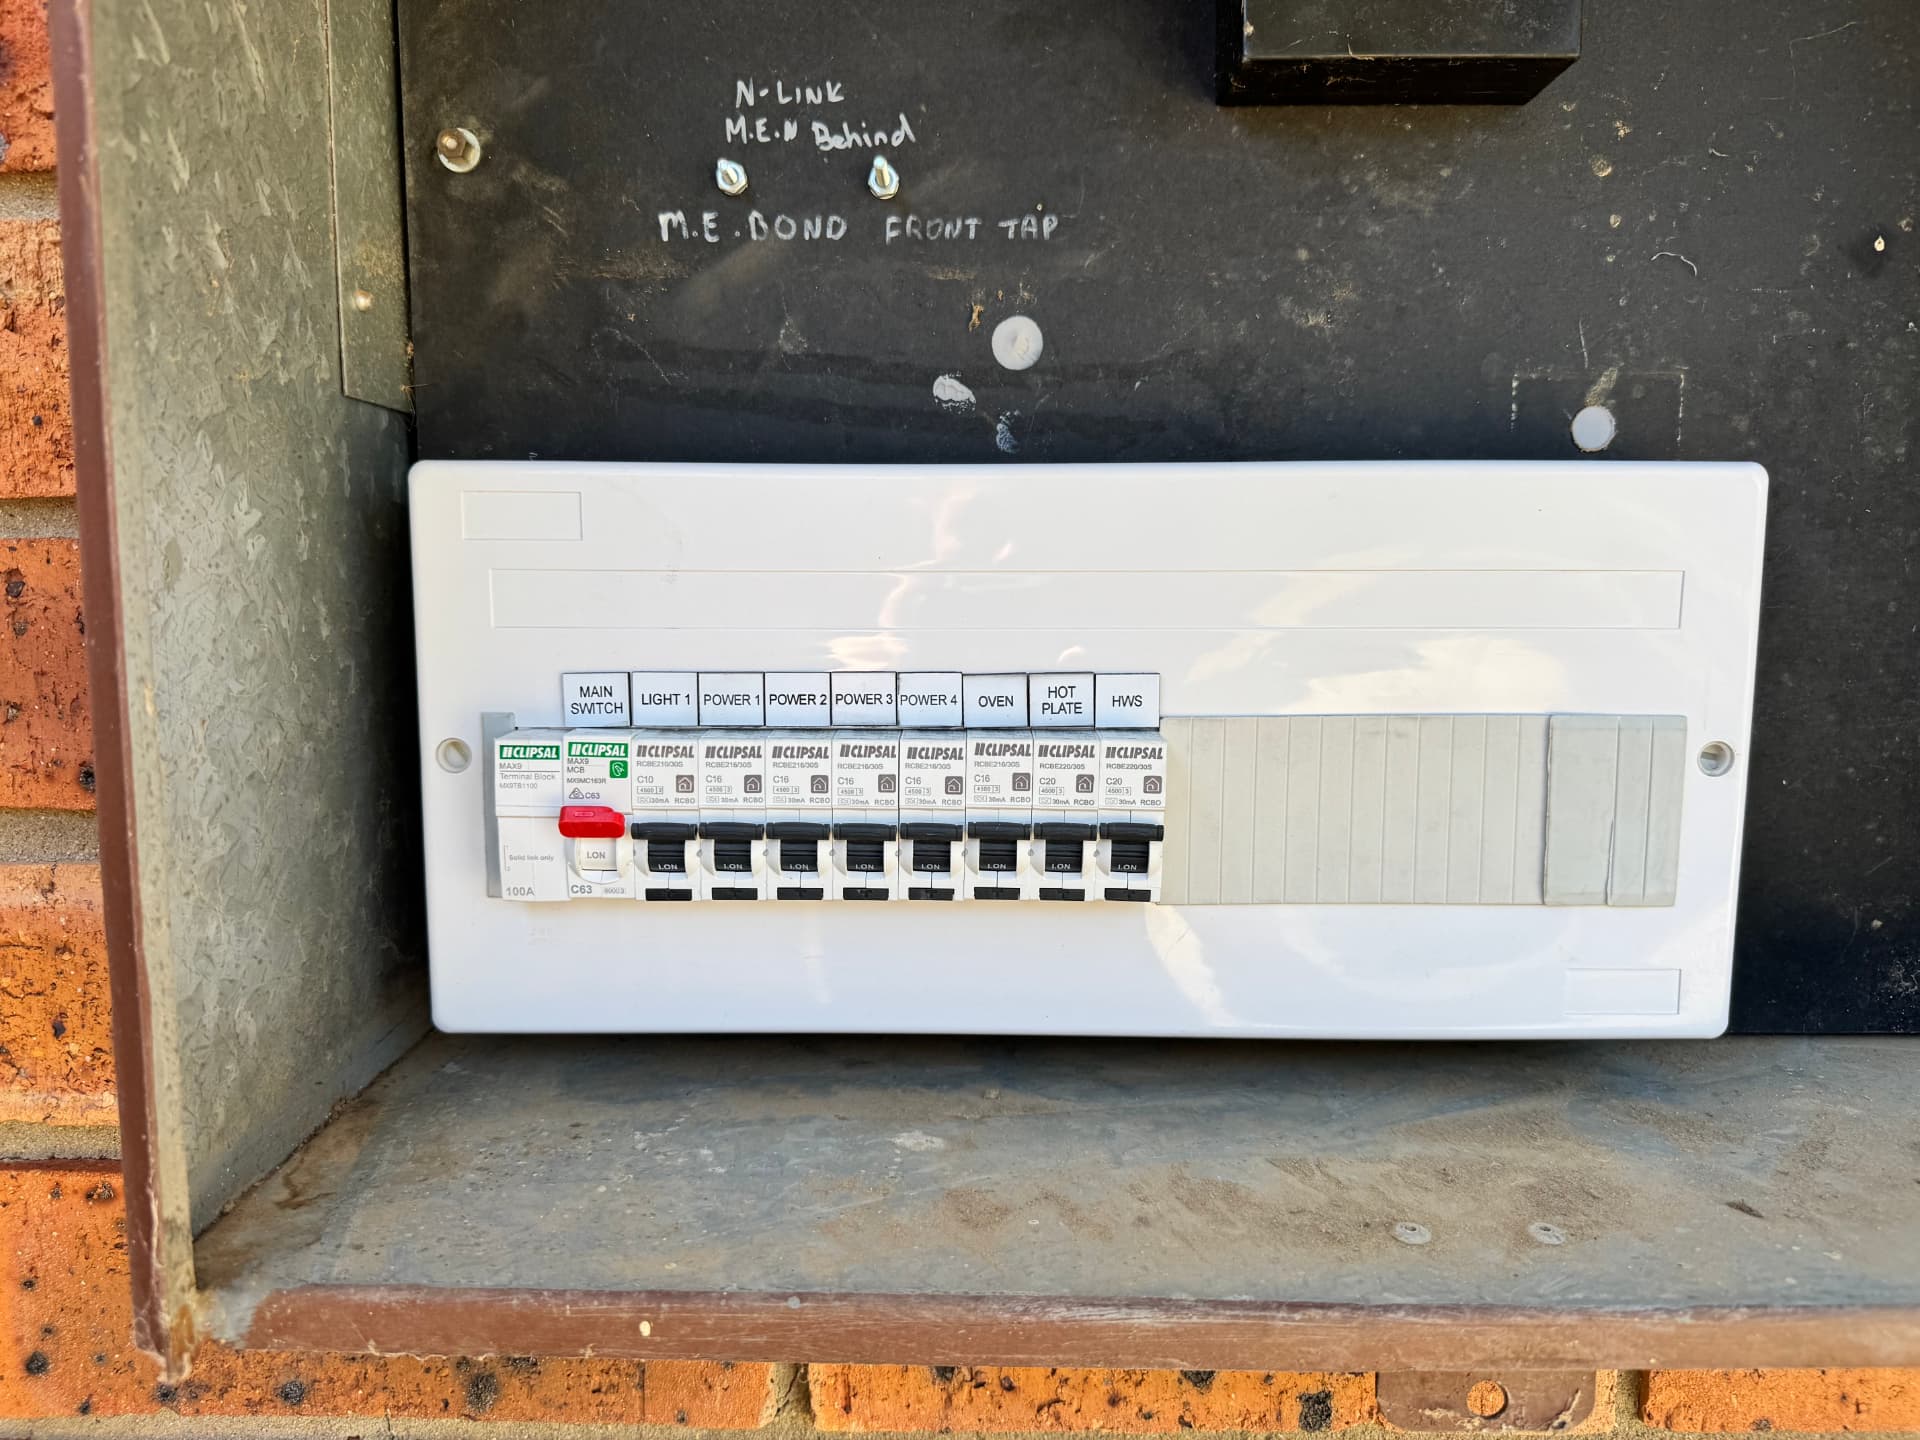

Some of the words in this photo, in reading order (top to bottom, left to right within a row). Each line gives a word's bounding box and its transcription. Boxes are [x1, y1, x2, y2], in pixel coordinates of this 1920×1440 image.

[735, 80, 845, 107] N-LINK
[812, 113, 916, 151] Behind
[885, 214, 982, 245] FRONT
[998, 214, 1058, 242] TAP
[579, 686, 613, 698] MAIN
[1047, 686, 1076, 698] HOT
[641, 693, 681, 705] LIGHT
[685, 693, 690, 705] 1
[703, 693, 751, 706] POWER
[755, 694, 760, 706] 1
[769, 693, 816, 705] POWER
[820, 694, 827, 705] 2
[835, 693, 883, 705] POWER
[886, 693, 893, 705] 3
[900, 694, 947, 706] POWER
[950, 694, 957, 706] 4
[978, 695, 1014, 707] OVEN
[1112, 695, 1143, 707] HWS
[570, 702, 624, 715] SWITCH
[1041, 702, 1082, 715] PLATE
[513, 747, 557, 758] CLIPSAL
[582, 743, 626, 757] CLIPSAL
[648, 745, 694, 758] CLIPSAL
[717, 746, 762, 759] CLIPSAL
[783, 746, 829, 759] CLIPSAL
[851, 745, 896, 758] CLIPSAL
[918, 747, 963, 760] CLIPSAL
[985, 743, 1031, 757] CLIPSAL
[1049, 745, 1095, 758] CLIPSAL
[1117, 746, 1163, 760] CLIPSAL
[567, 766, 585, 774] MCB
[637, 776, 654, 784] C10
[705, 775, 722, 783] C16
[837, 777, 854, 785] C16
[905, 777, 921, 785] C16
[1040, 777, 1056, 785] C20
[1106, 777, 1122, 785] C20
[505, 887, 535, 896] 100A
[570, 884, 593, 894] C63
